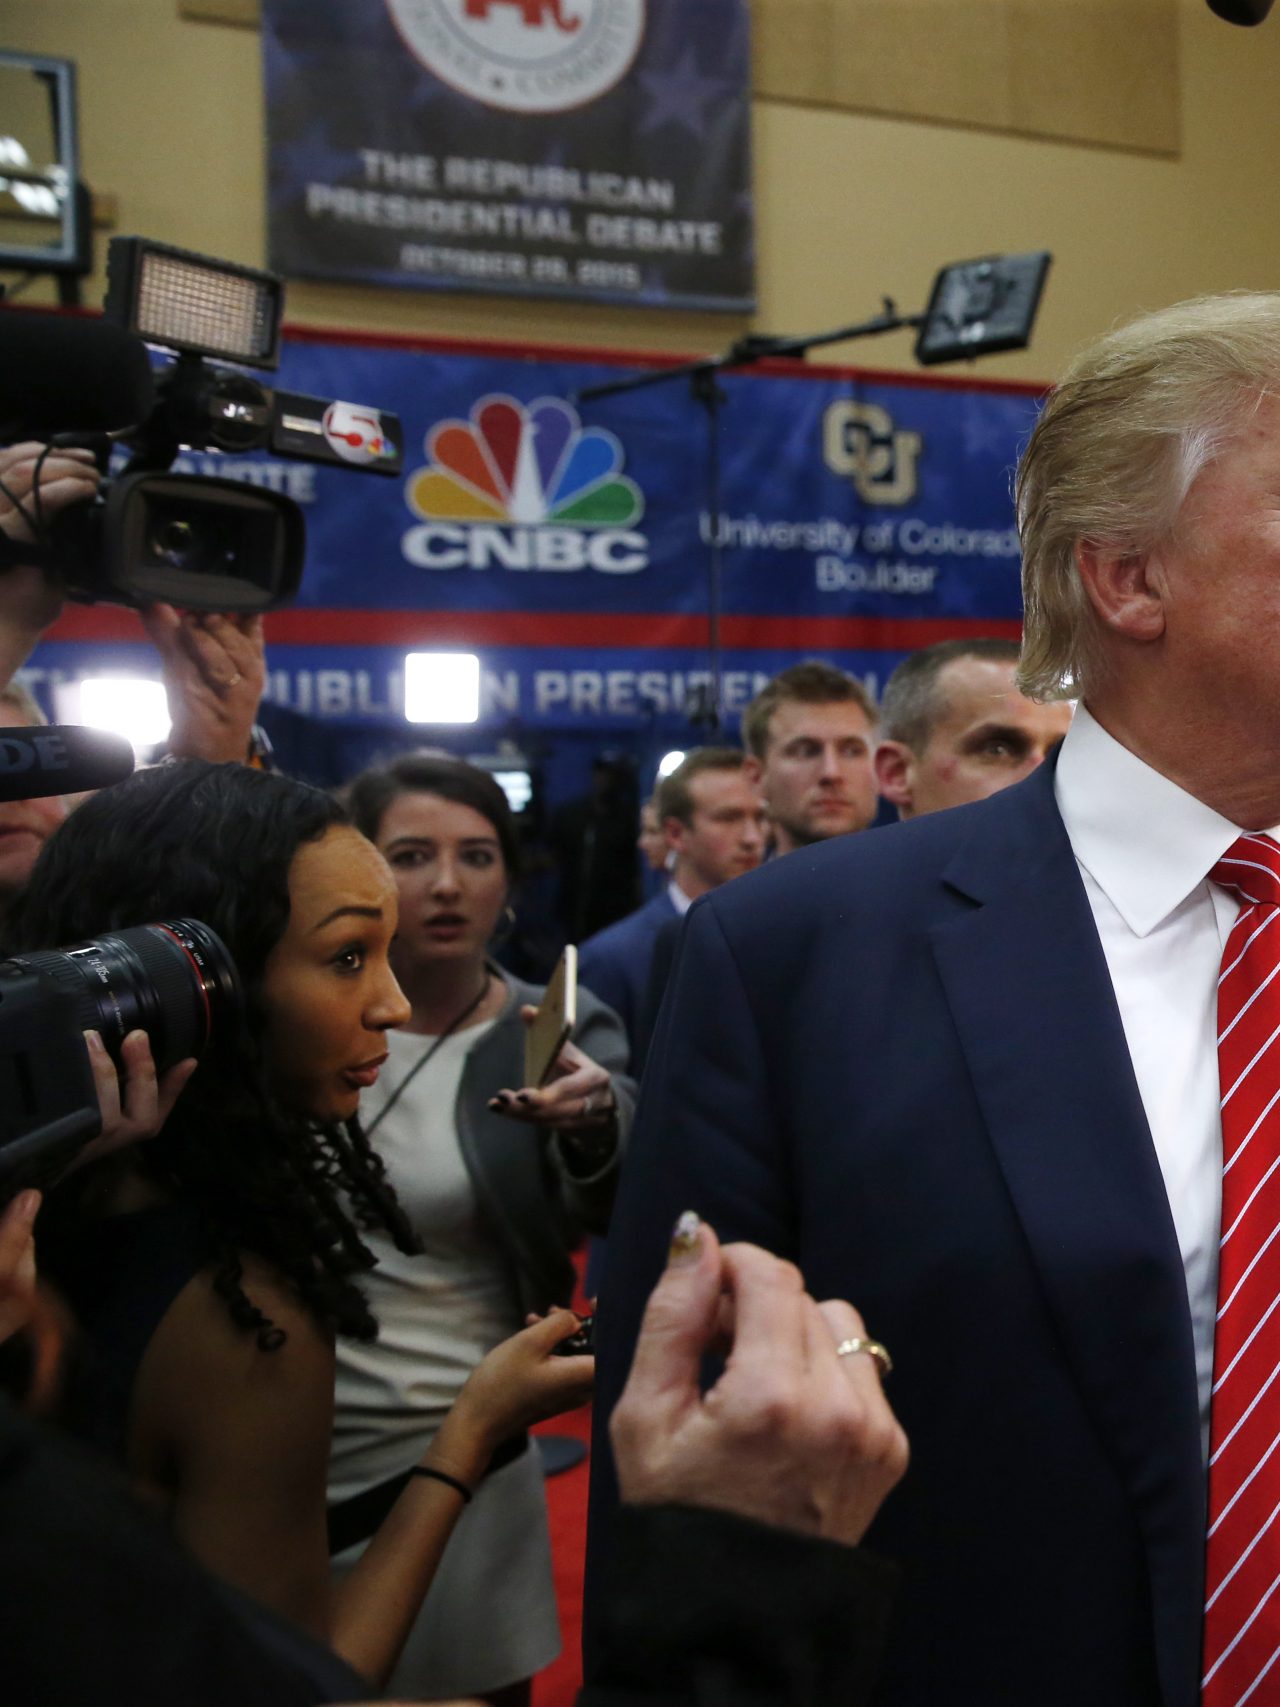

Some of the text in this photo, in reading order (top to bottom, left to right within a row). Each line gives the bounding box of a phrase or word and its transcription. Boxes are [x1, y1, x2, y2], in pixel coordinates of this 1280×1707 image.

[358, 148, 675, 213] THE REPUBLICAN
[304, 182, 723, 255] PRESIDENTIAL DEBATE
[822, 398, 922, 506] CU
[402, 526, 649, 575] CNBC
[700, 513, 1022, 557] University of Colorad
[816, 556, 938, 594] Boulder
